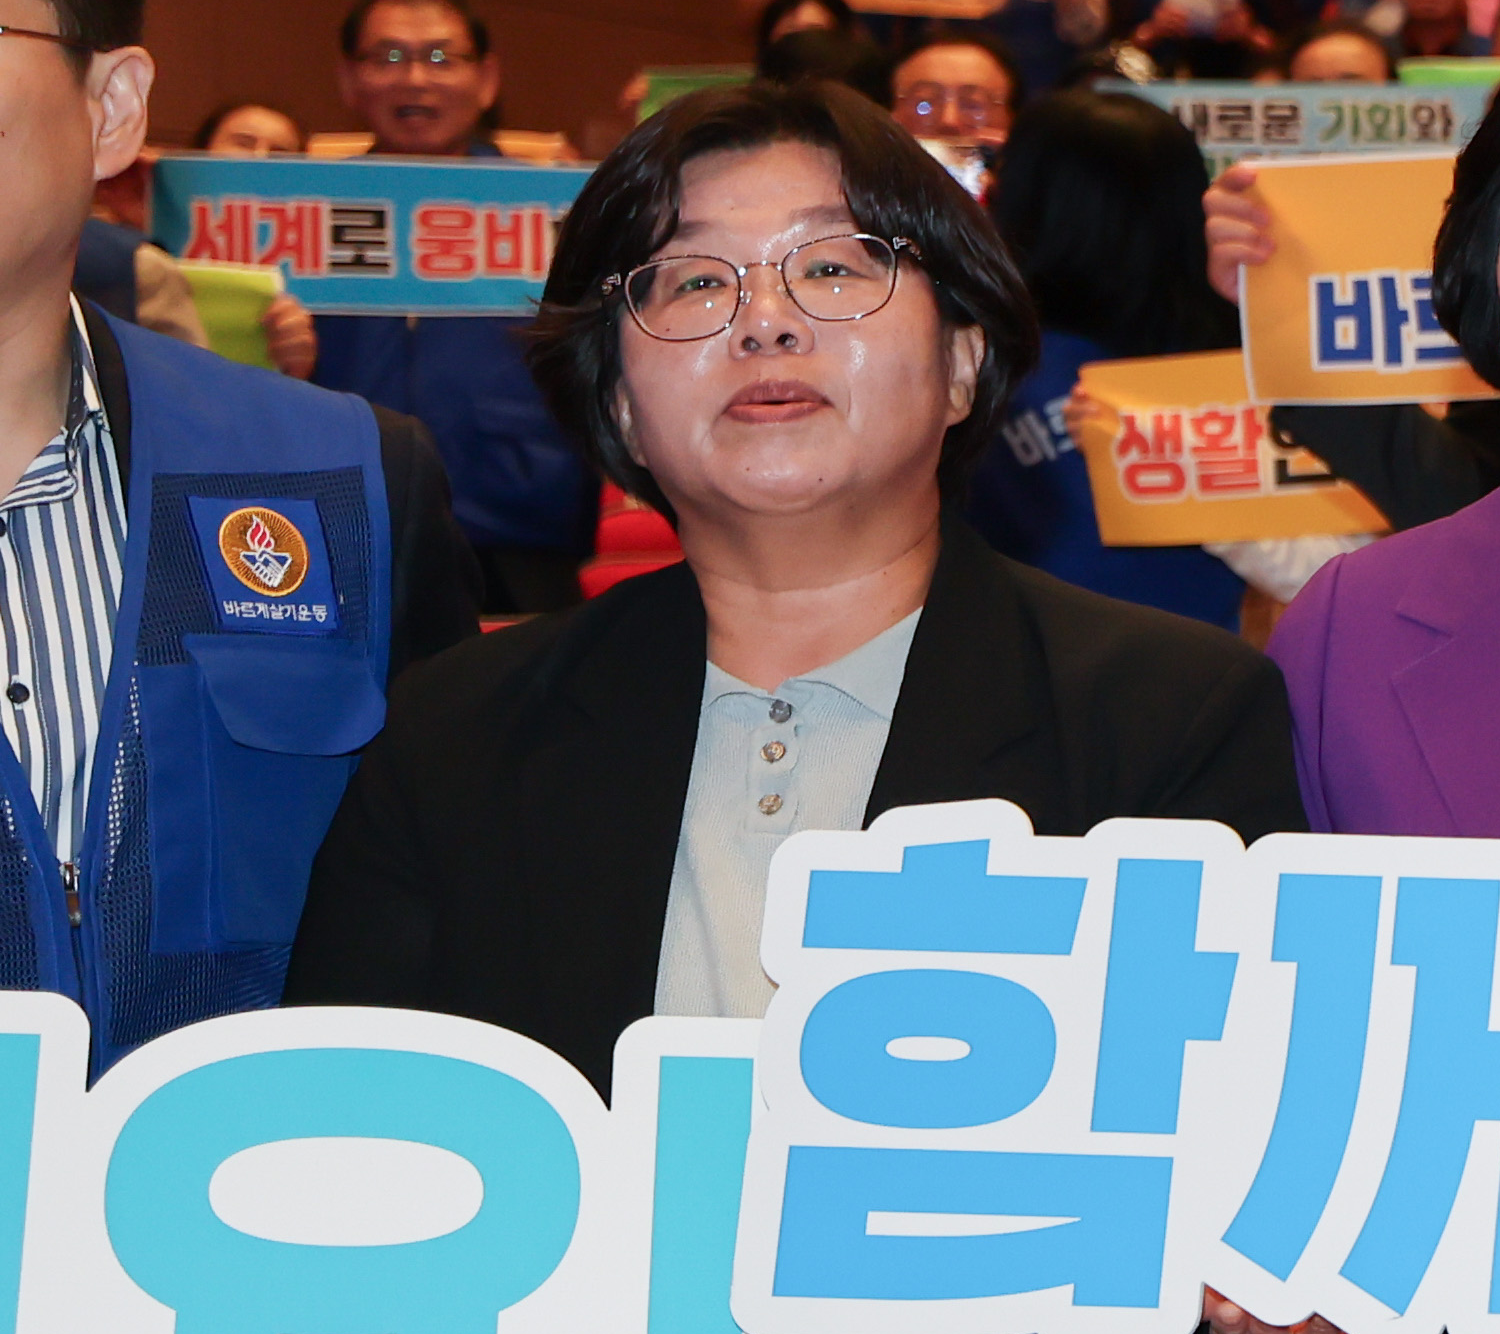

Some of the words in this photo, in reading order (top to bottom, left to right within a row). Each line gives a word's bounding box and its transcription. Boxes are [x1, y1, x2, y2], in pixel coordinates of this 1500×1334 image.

[182, 202, 391, 275] 세계로
[414, 205, 562, 278] 웅비
[223, 600, 328, 623] 바르게살기운동
